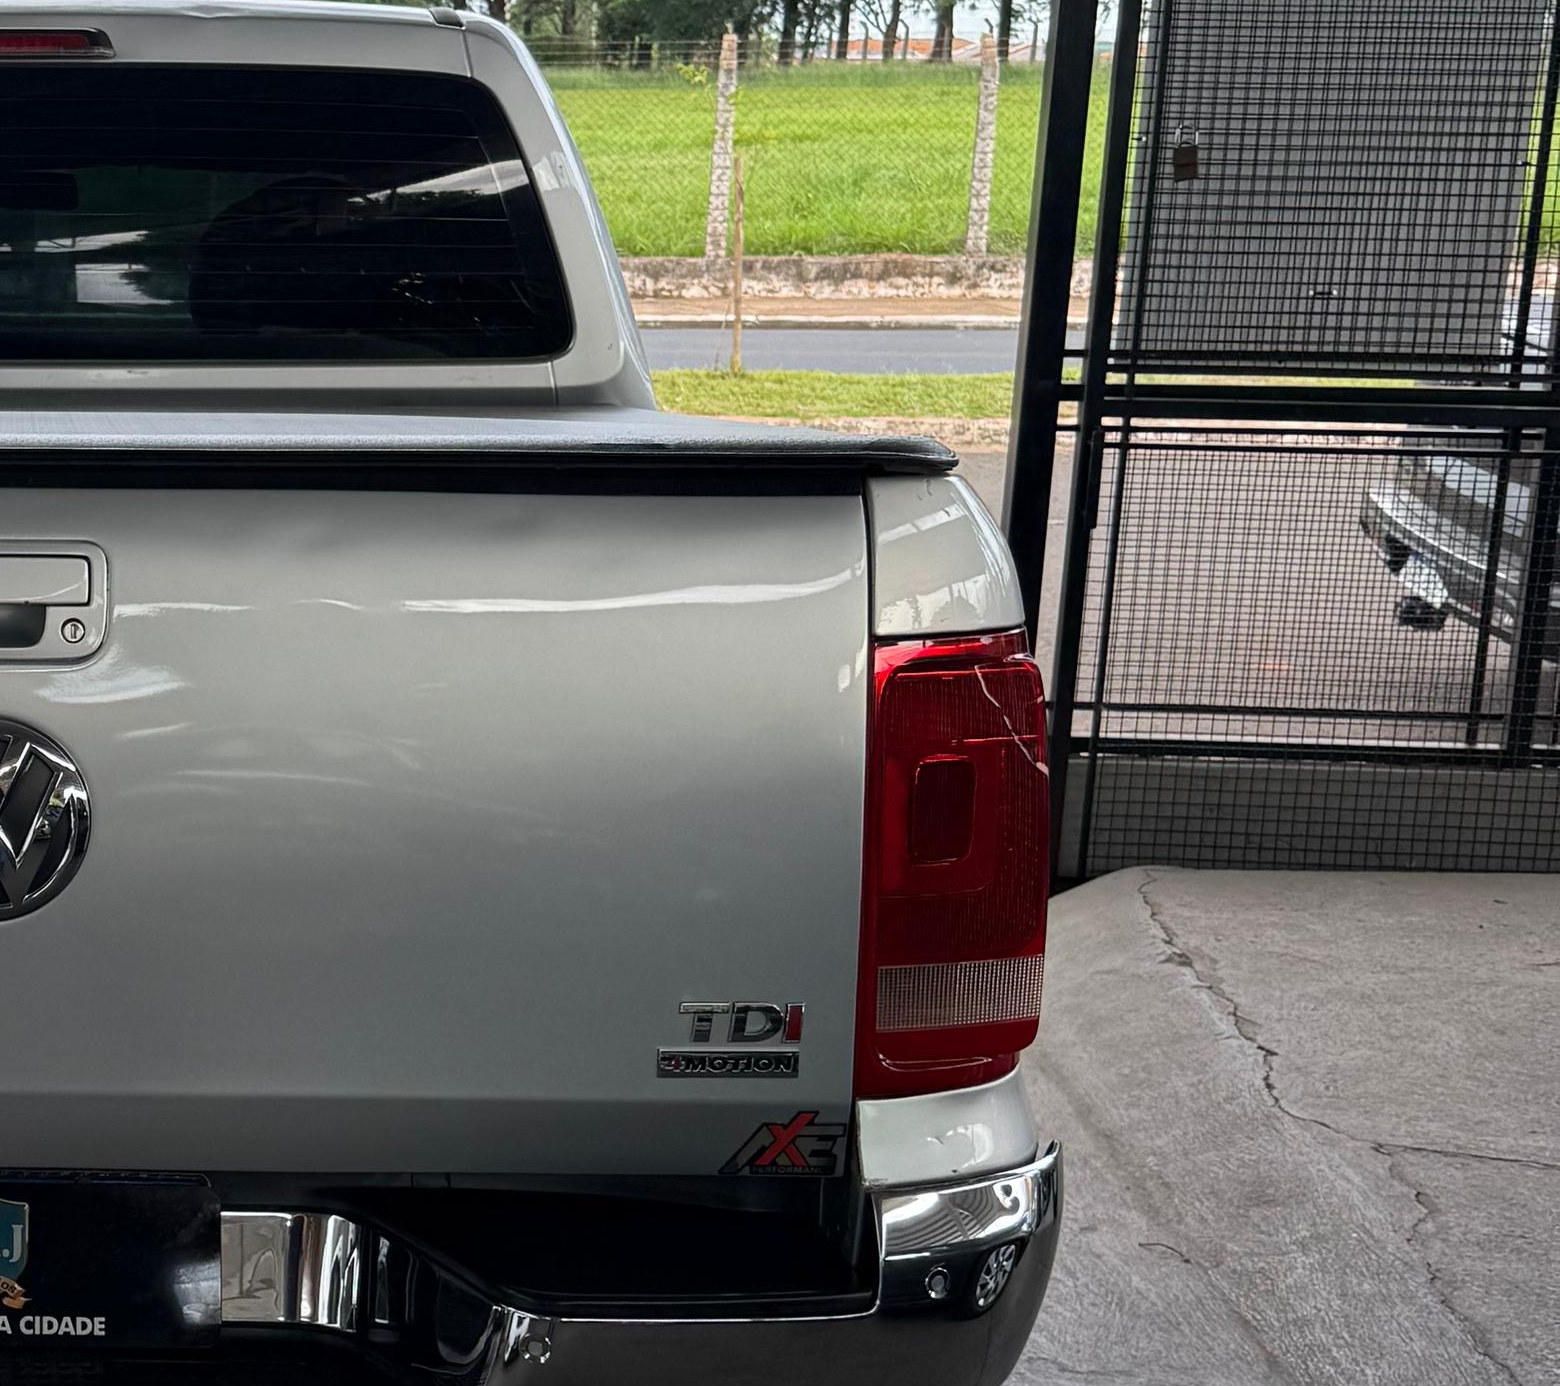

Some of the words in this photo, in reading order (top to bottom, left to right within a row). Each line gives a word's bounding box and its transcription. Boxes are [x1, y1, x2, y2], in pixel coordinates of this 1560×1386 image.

[679, 1001, 806, 1043] TDI
[660, 1054, 794, 1073] 4MOTION
[752, 1165, 831, 1174] PERFORMANC
[19, 1316, 107, 1337] CIDADE
